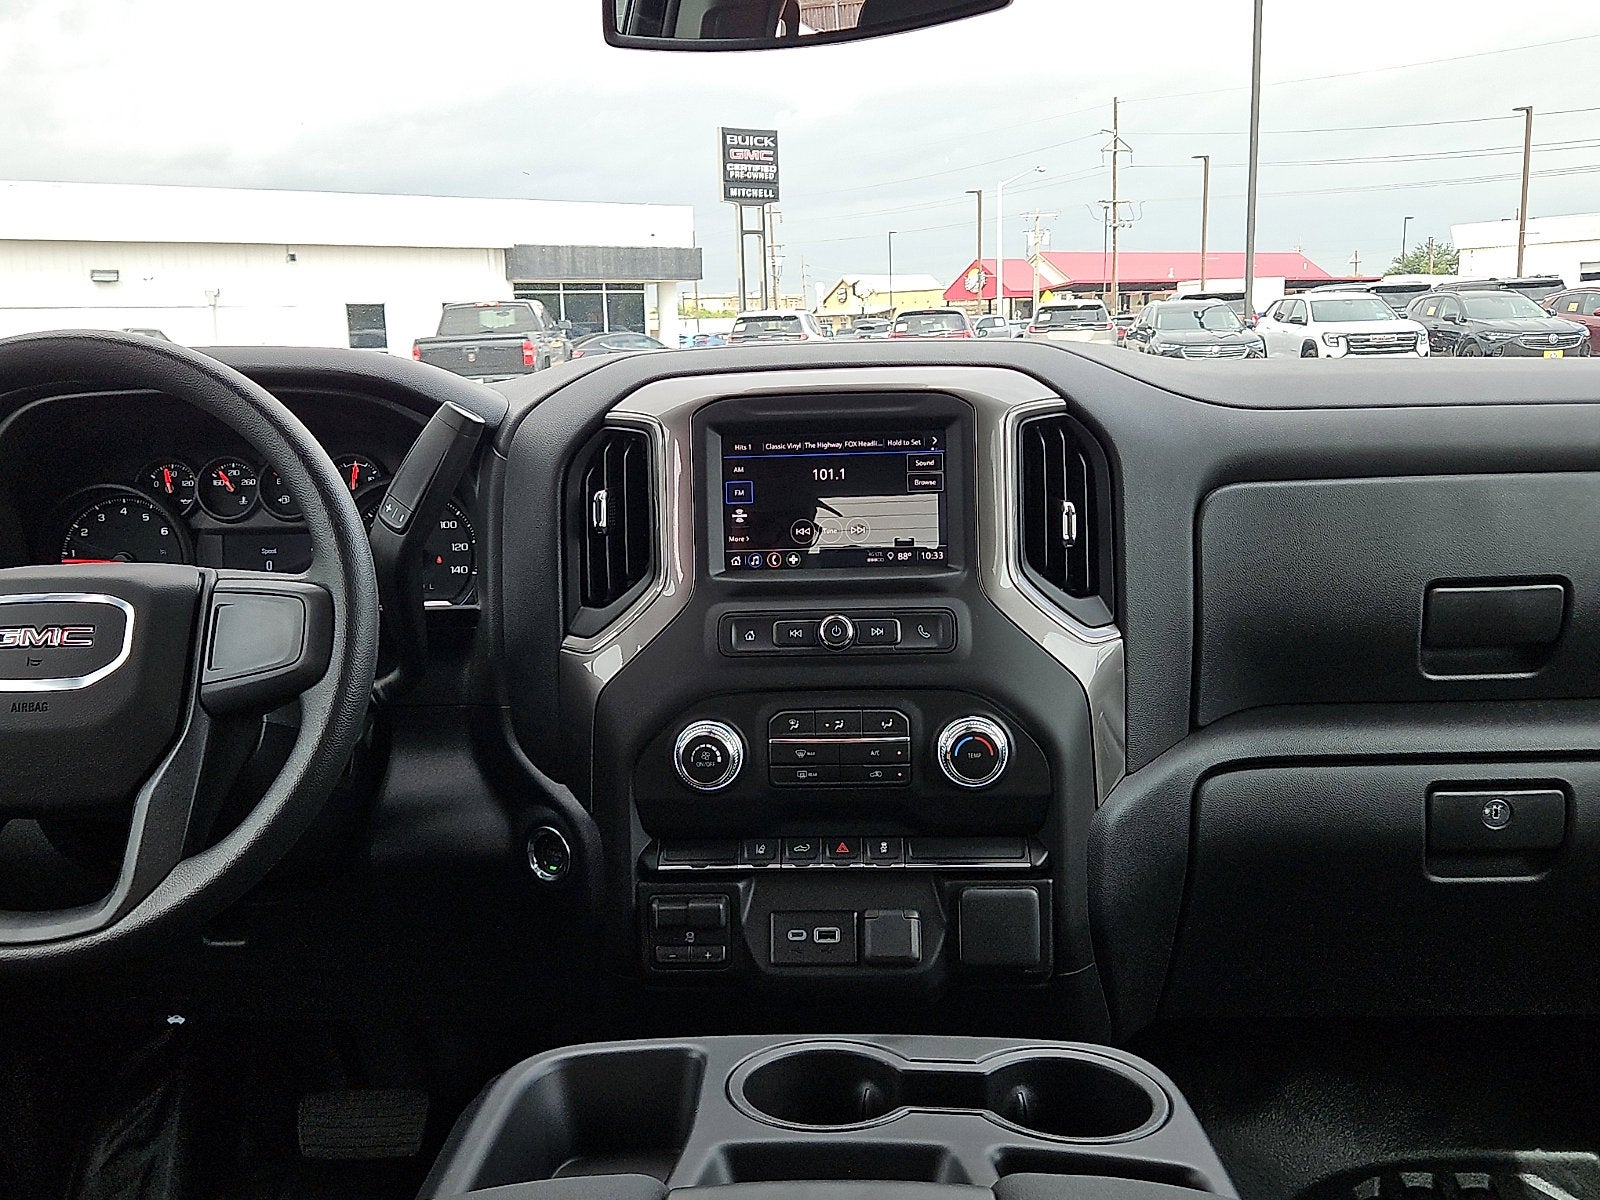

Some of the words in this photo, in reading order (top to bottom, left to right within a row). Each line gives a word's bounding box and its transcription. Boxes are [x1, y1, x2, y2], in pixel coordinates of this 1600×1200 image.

[726, 134, 776, 147] BUICK
[729, 148, 774, 162] GMC
[726, 163, 777, 173] CERTIFIED
[729, 170, 775, 180] PRE-OWNED
[729, 187, 775, 198] MITCHELL
[786, 442, 801, 451] Vinyl
[804, 441, 816, 449] The
[816, 441, 843, 450] Highway
[844, 440, 857, 448] FOX
[887, 438, 902, 446] Hold
[910, 438, 921, 446] Set
[734, 443, 747, 451] Hits
[748, 443, 752, 451] 1
[915, 459, 935, 467] Sound
[812, 467, 846, 481] 101.1
[153, 480, 160, 488] 0
[734, 489, 745, 497] FM
[119, 507, 128, 516] 4
[97, 513, 106, 522] 3
[141, 513, 150, 522] 5
[439, 520, 458, 530] 100
[80, 528, 88, 537] 2
[160, 527, 169, 536] 6
[451, 542, 469, 551] 120
[71, 549, 76, 558] 1
[921, 551, 944, 560] 10:33
[265, 560, 273, 571] 0
[450, 565, 469, 574] 140
[0, 626, 95, 648] GMC
[10, 701, 49, 714] AIRBAG
